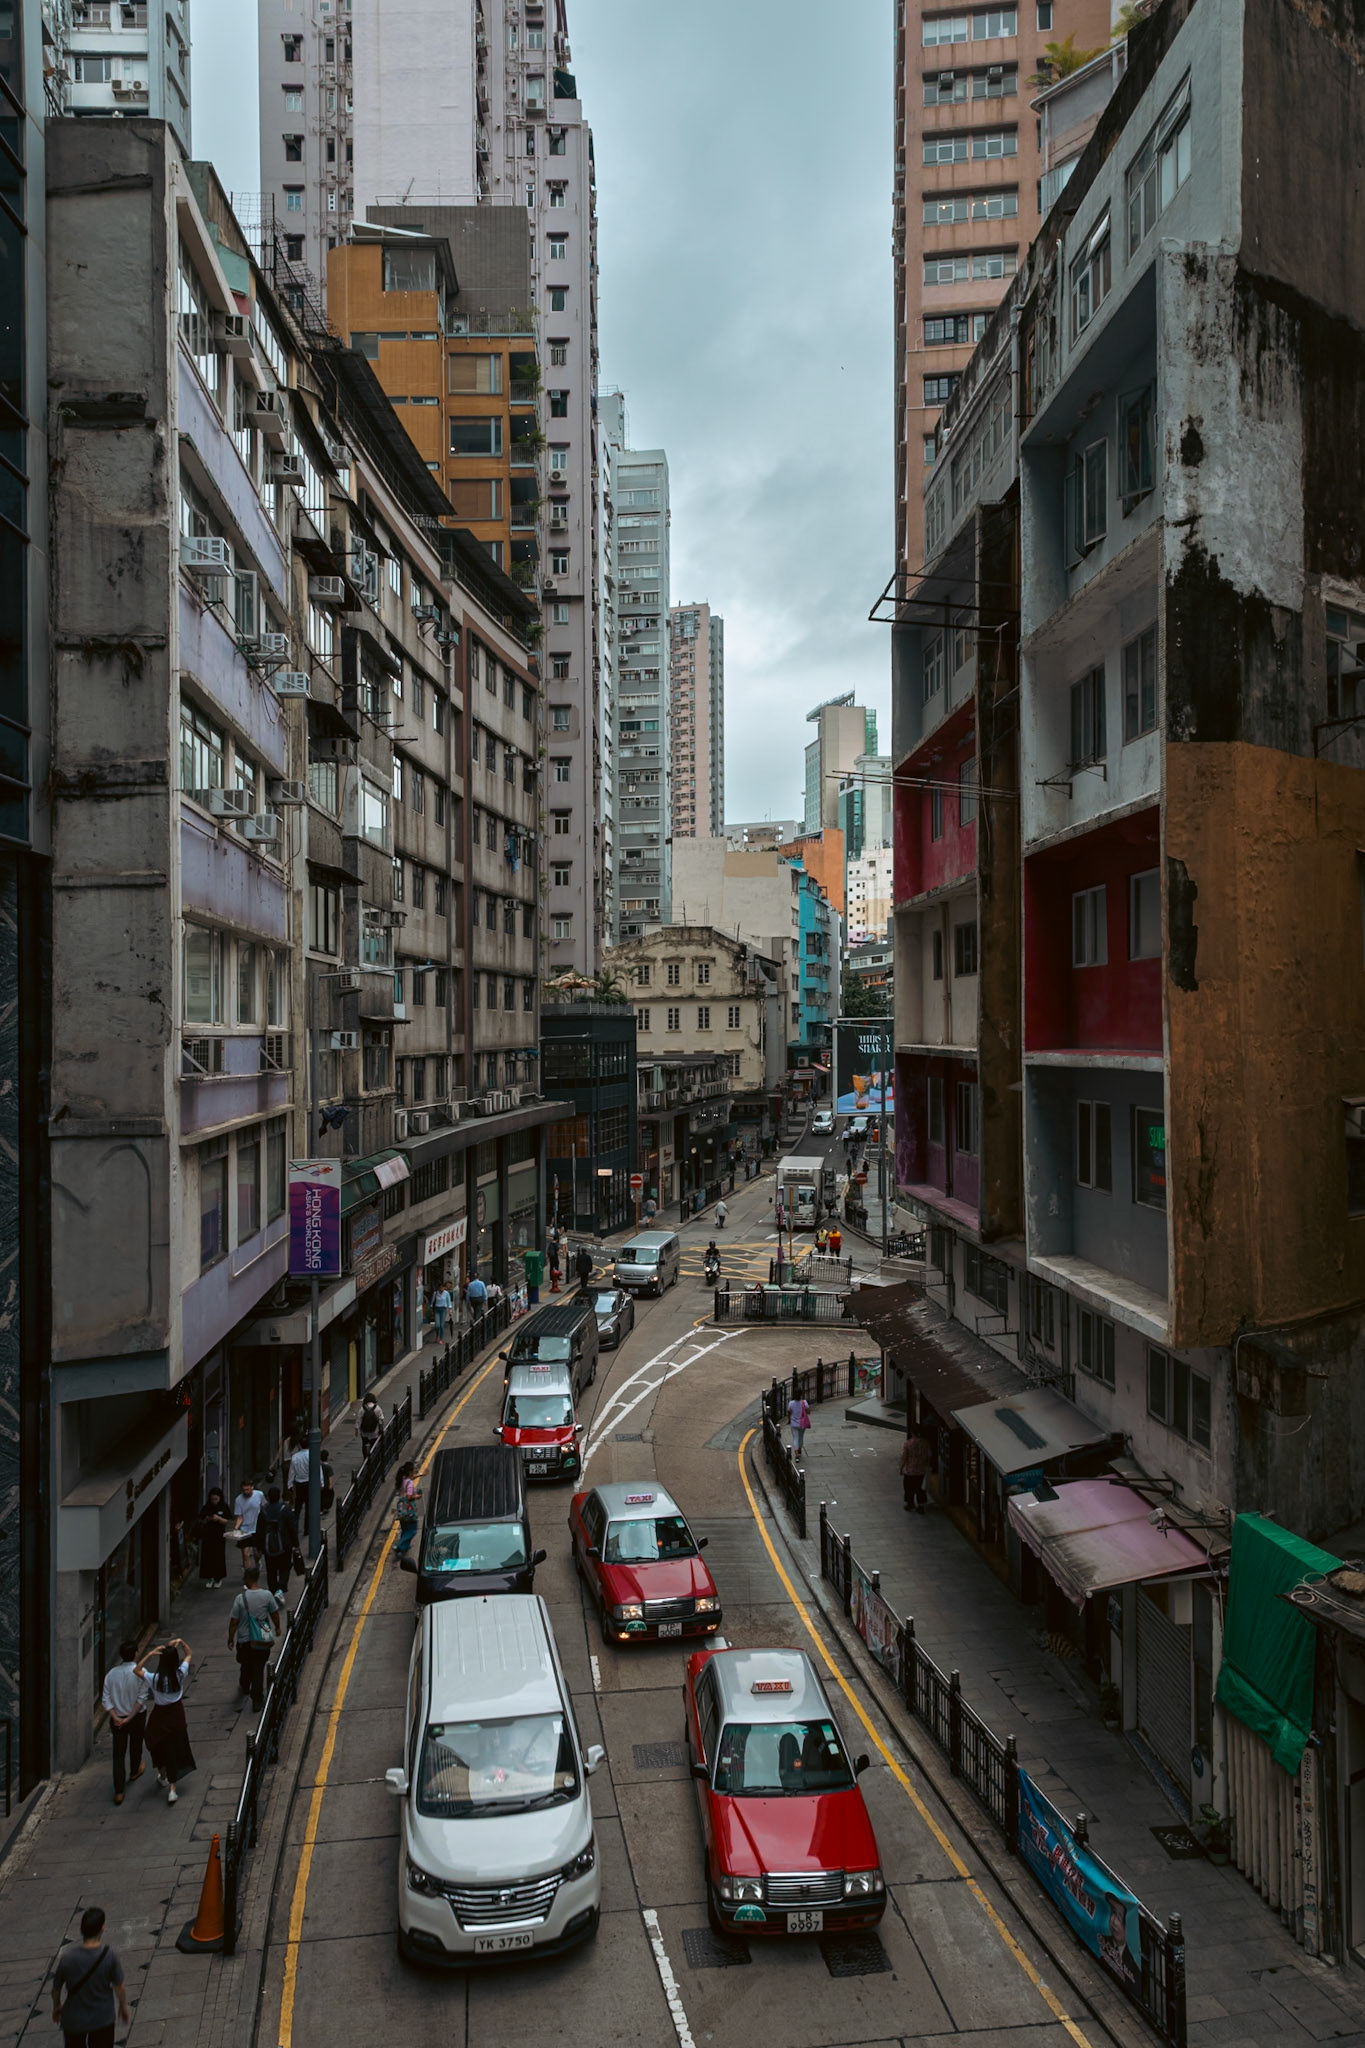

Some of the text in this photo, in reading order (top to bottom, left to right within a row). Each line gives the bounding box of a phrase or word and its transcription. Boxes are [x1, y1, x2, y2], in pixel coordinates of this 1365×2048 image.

[858, 1034, 891, 1044] THIRSY
[858, 1044, 891, 1053] SHAKR
[312, 1189, 321, 1268] HONG KONG
[755, 1682, 790, 1691] TAXI
[798, 1912, 812, 1922] LR
[790, 1921, 820, 1931] 9997
[479, 1935, 530, 1951] YK 3750
